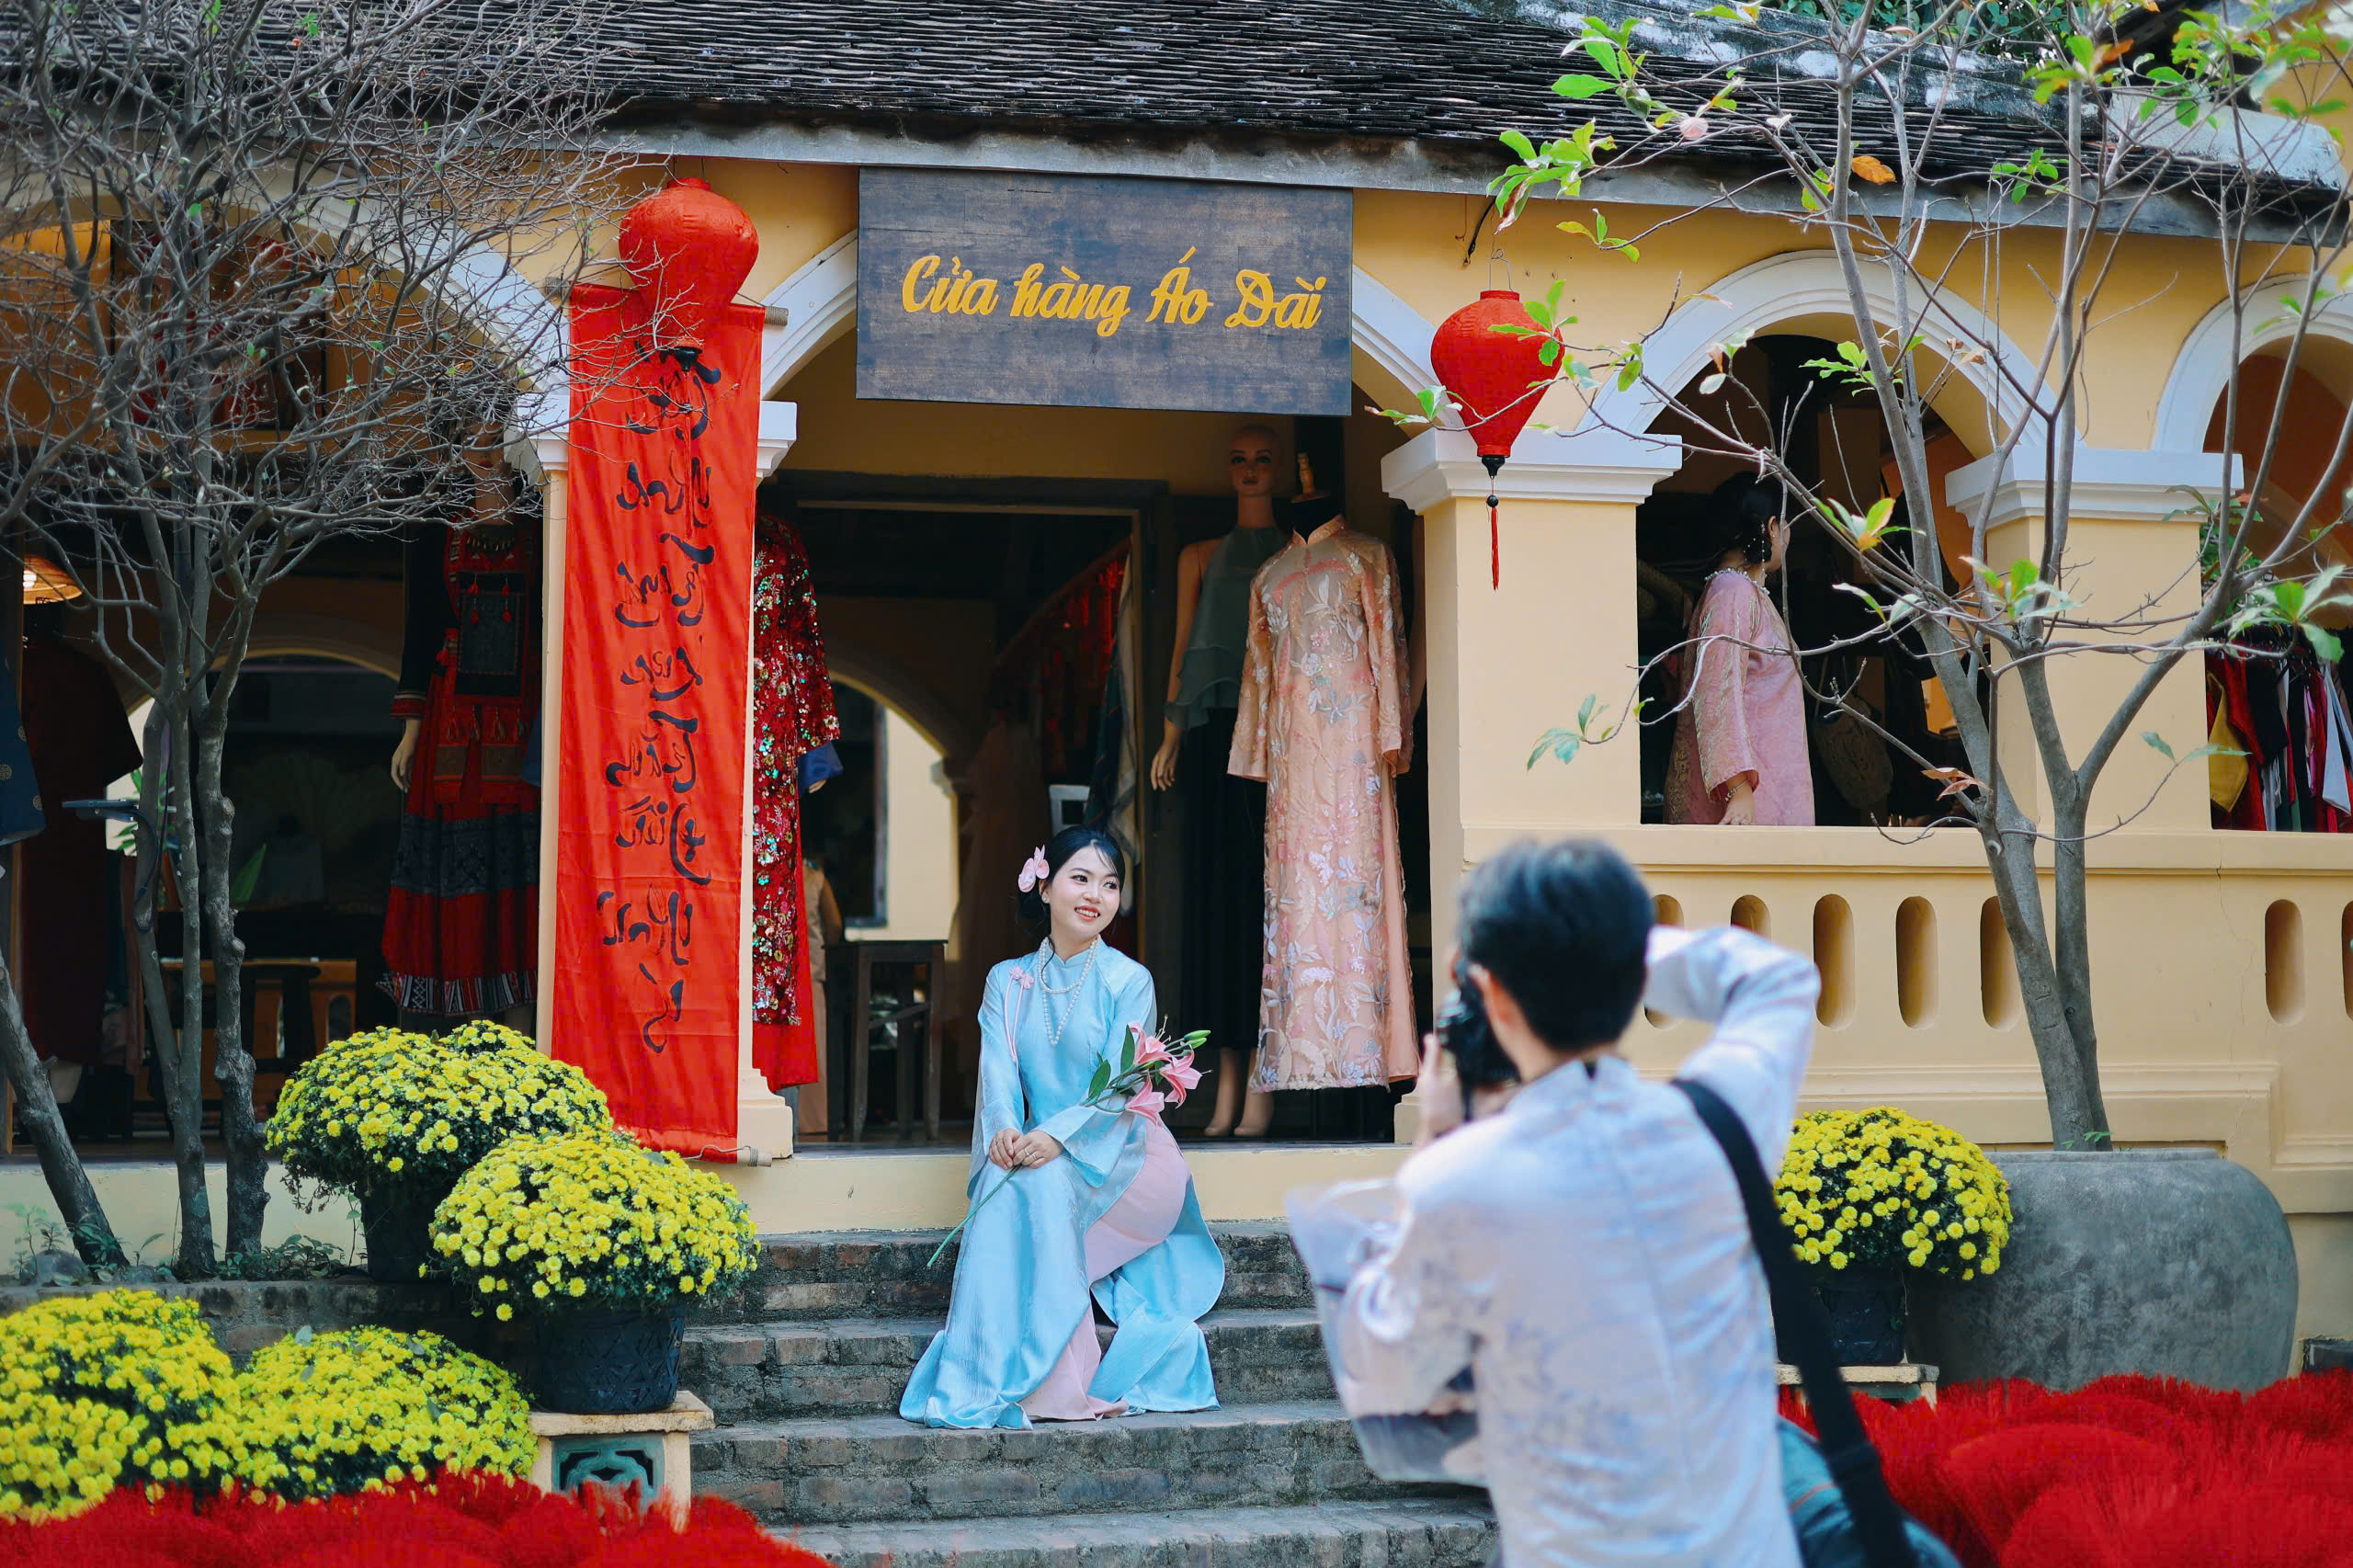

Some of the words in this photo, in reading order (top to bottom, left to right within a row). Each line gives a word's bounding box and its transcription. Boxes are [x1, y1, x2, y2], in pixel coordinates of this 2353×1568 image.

[902, 256, 1000, 316] Cửa
[1010, 263, 1131, 337] hàng
[1145, 246, 1215, 324] Áo
